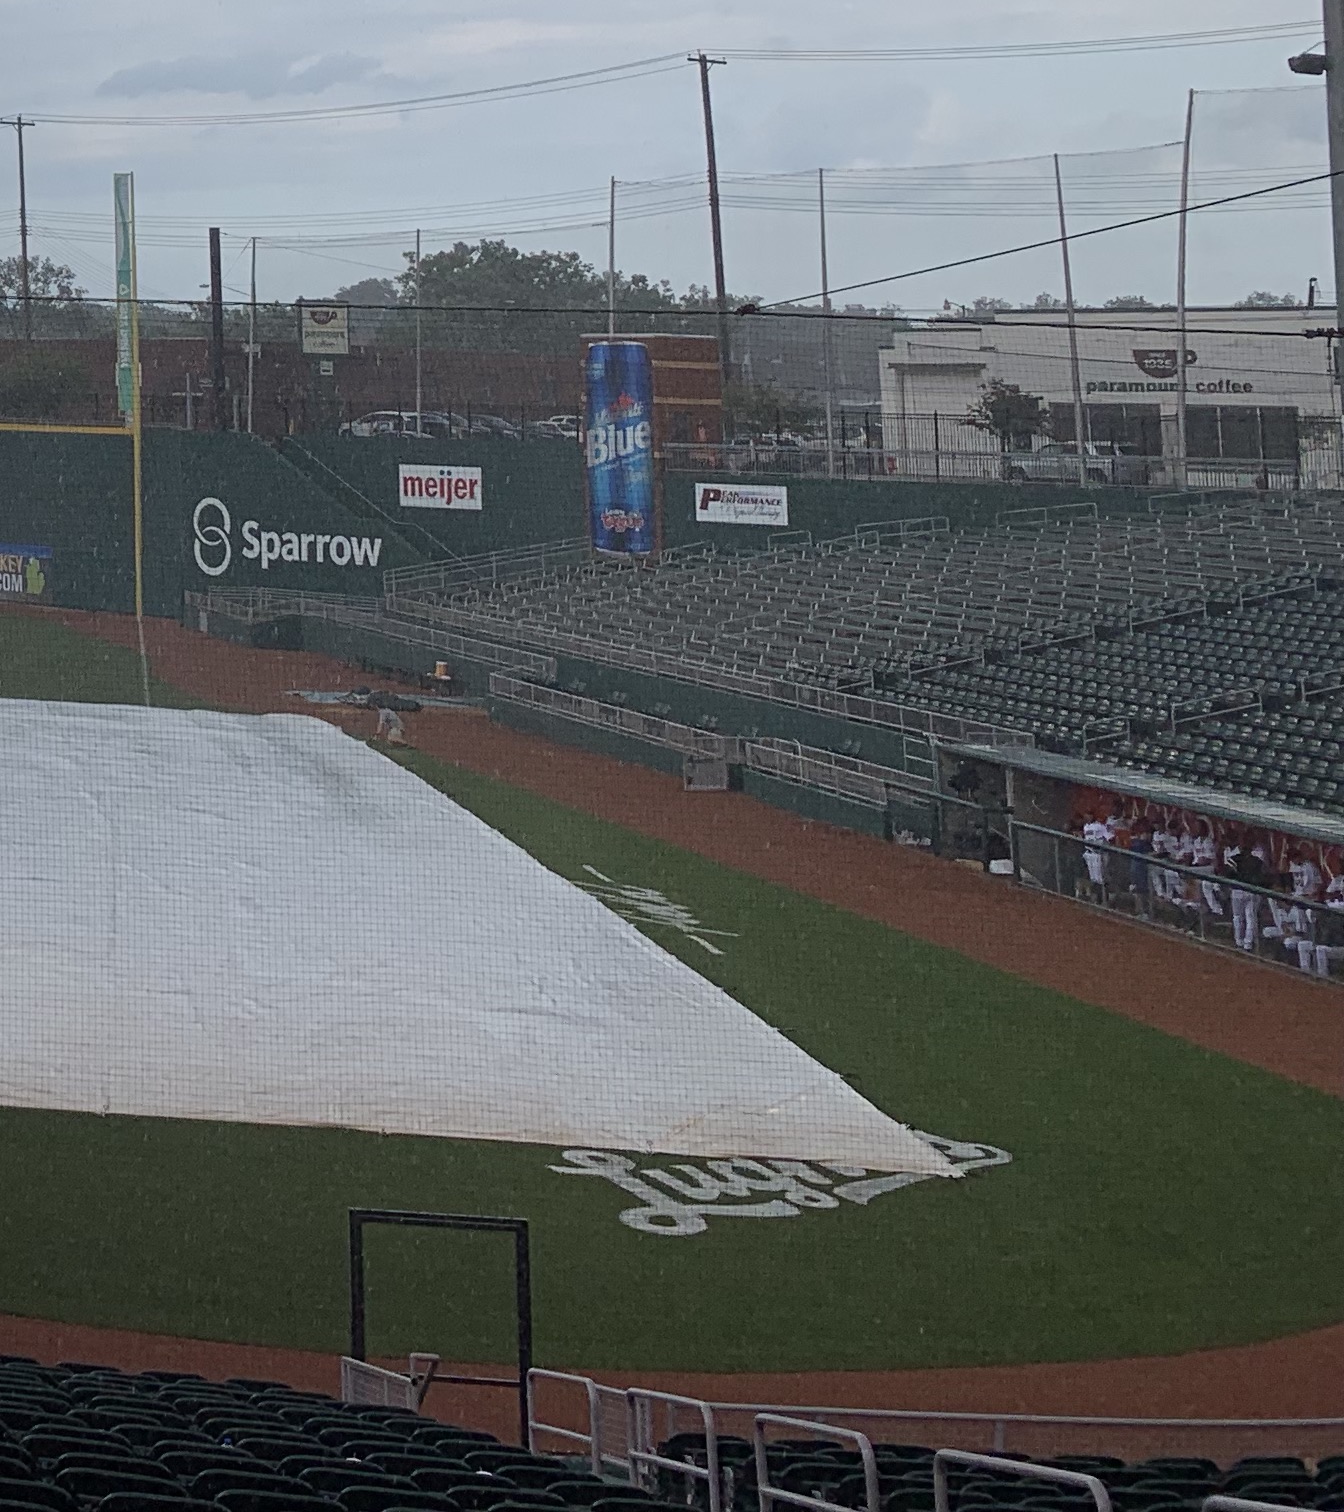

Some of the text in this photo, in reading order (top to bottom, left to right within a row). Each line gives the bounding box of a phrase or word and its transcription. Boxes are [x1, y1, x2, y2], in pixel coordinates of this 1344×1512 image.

[1195, 379, 1253, 393] coffee
[587, 421, 650, 467] Blue
[403, 470, 478, 505] meijer
[242, 520, 382, 569] Sparrow
